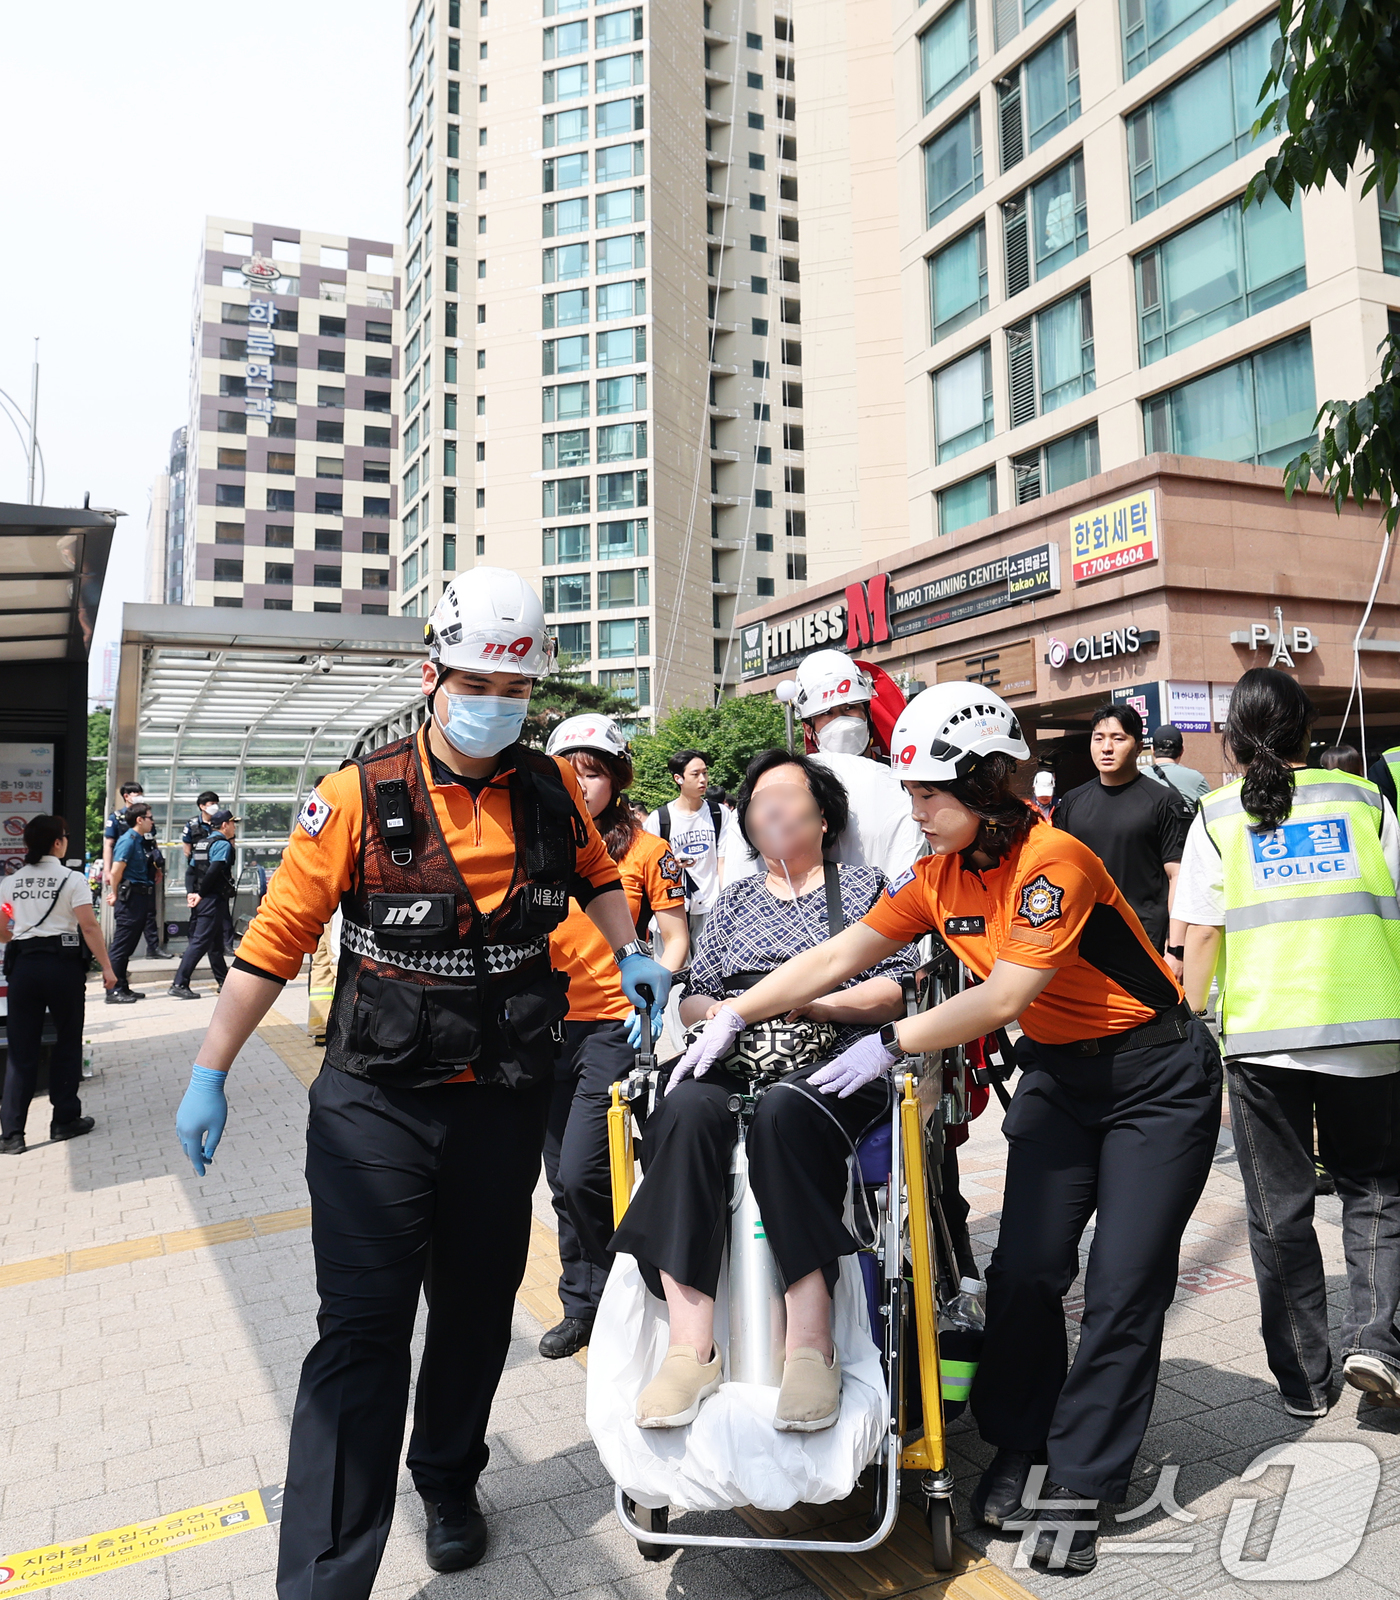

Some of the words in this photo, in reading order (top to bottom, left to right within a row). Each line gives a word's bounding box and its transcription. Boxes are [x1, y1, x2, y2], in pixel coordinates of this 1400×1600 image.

[1075, 501, 1147, 557] 한화세탁
[1009, 551, 1049, 577] 스크린골프
[1081, 546, 1144, 576] T.706-6604
[896, 588, 921, 610] MAPO
[923, 575, 967, 601] TRAINING
[969, 559, 1008, 585] CENTER
[1010, 578, 1034, 593] kakao
[1036, 571, 1049, 585] VX
[762, 605, 844, 660] FITNESS
[1073, 626, 1140, 663] OLENS
[479, 636, 533, 662] 119
[822, 679, 851, 702] 119
[1181, 692, 1206, 700] 하나투어
[974, 719, 987, 728] 서울
[980, 725, 1000, 736] 소방서
[25, 781, 42, 790] 예방
[1263, 859, 1346, 879] POLICE
[15, 877, 57, 888] 교통경찰
[13, 890, 58, 901] POLICE
[1033, 897, 1046, 905] 119
[382, 900, 431, 924] 119
[23, 1544, 88, 1567] 지하철
[97, 1526, 159, 1549] 출입구
[165, 1500, 246, 1530] 금연구역
[13, 1582, 38, 1592] AREA
[40, 1575, 66, 1585] within
[79, 1564, 109, 1575] meters
[132, 1546, 168, 1559] SUBWAY
[171, 1536, 207, 1548] entrance
[209, 1521, 255, 1538] boundaries
[21, 1553, 101, 1580] (시설경계
[106, 1545, 133, 1559] 4면
[140, 1521, 215, 1549] 10m이내)
